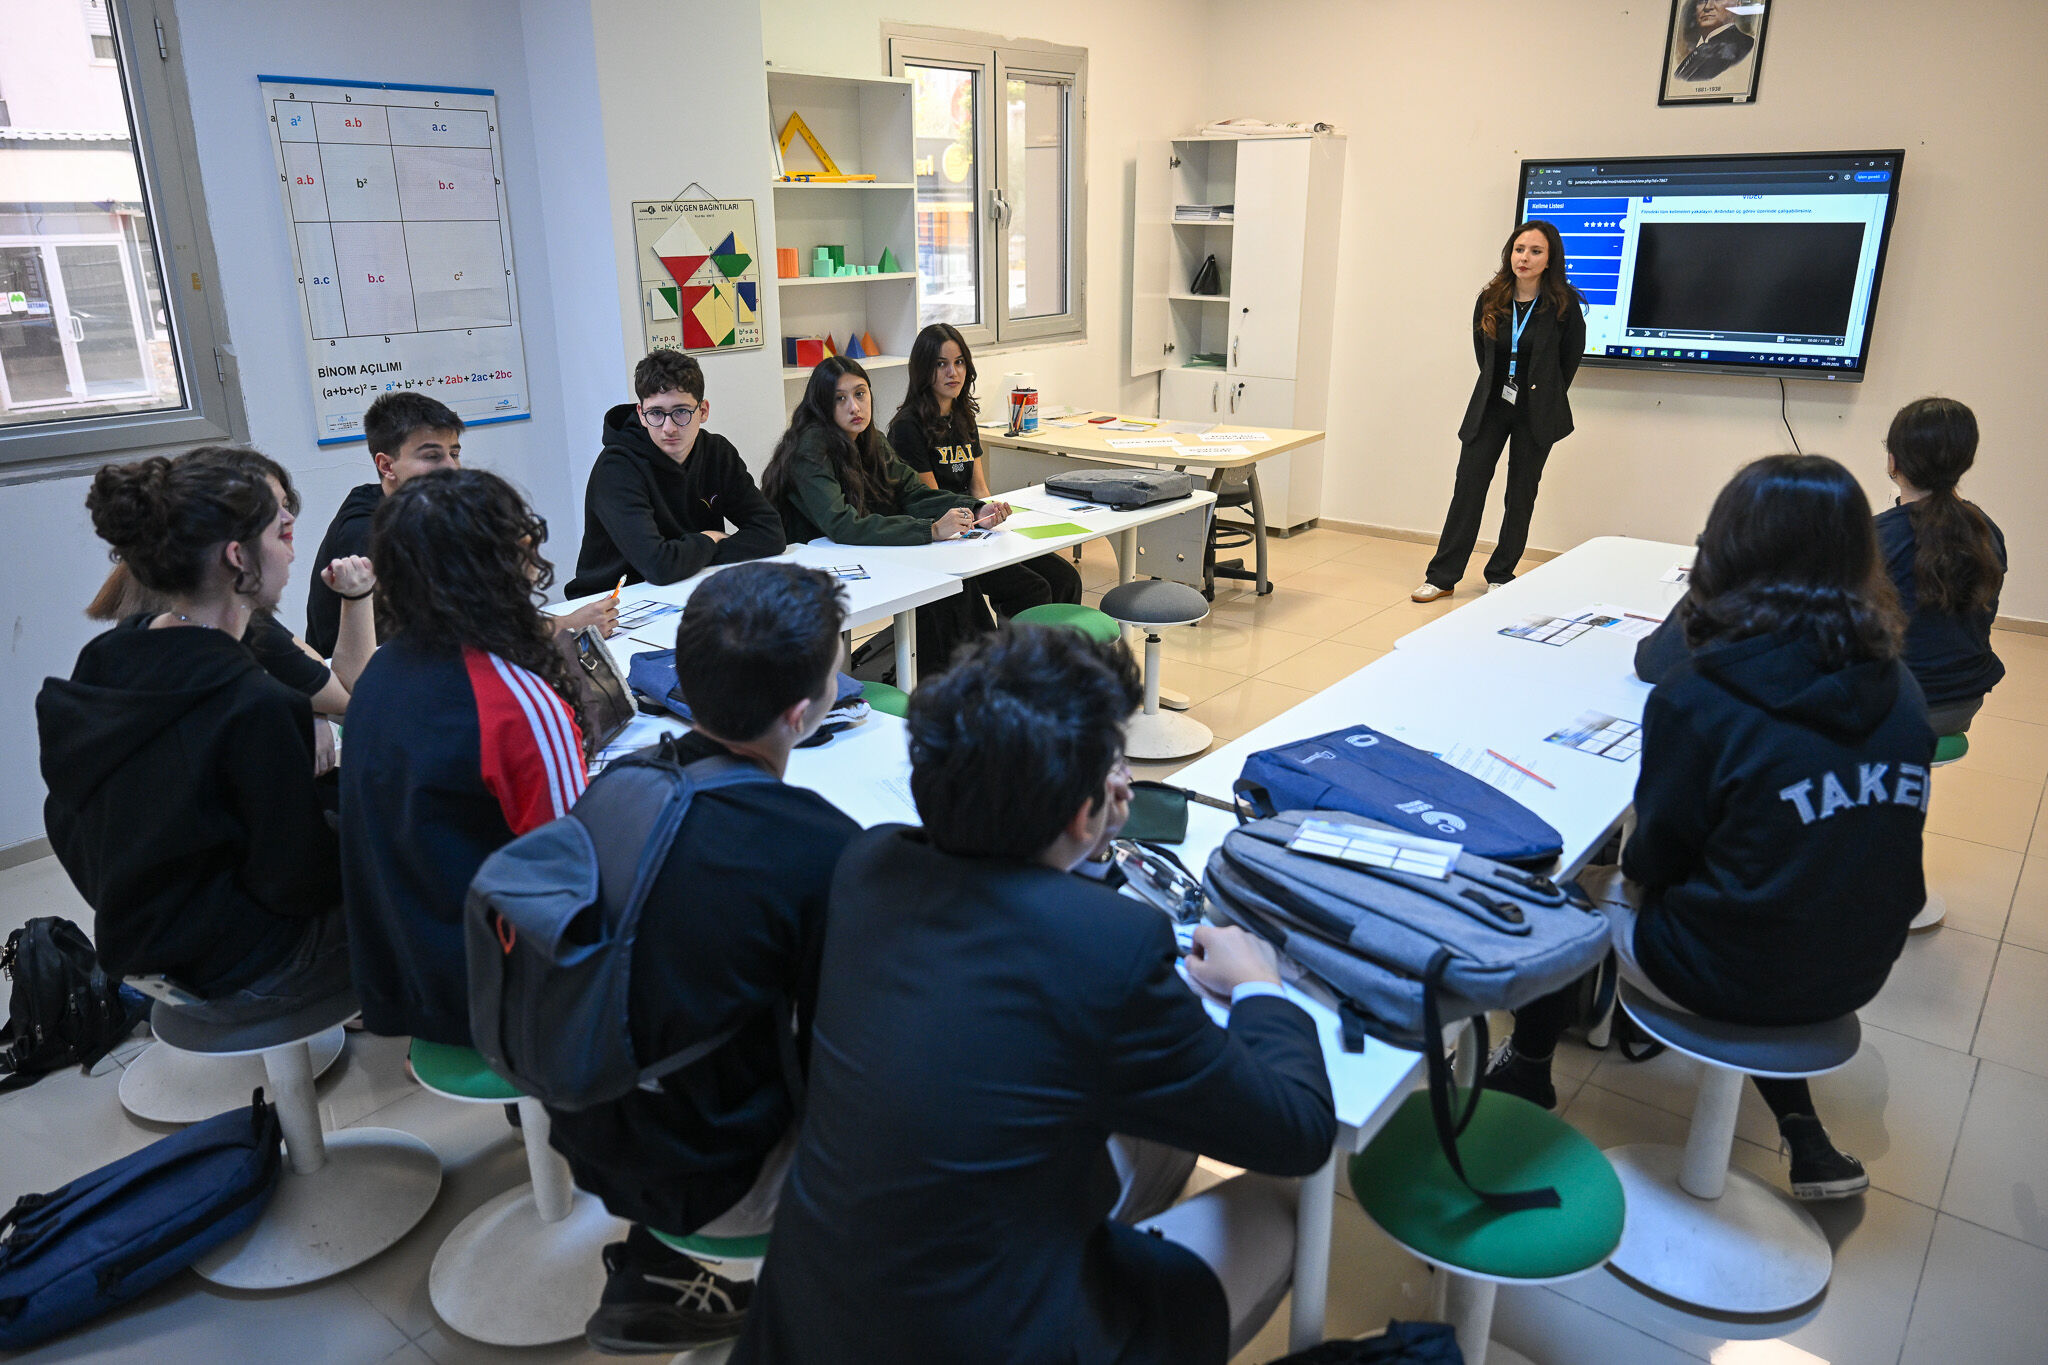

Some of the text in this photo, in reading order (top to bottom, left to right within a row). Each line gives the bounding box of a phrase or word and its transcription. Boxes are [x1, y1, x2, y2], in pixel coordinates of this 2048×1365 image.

[345, 94, 352, 103] b
[344, 117, 362, 128] a.b
[432, 123, 447, 132] a.c
[296, 174, 314, 185] a.b
[439, 180, 455, 190] b.c
[661, 203, 739, 213] DİK ÜÇGEN BAĞINTILARI
[313, 275, 330, 285] a.c
[368, 273, 385, 283] b.c
[385, 335, 391, 344] b
[317, 361, 402, 378] BİNOM AÇILIMI
